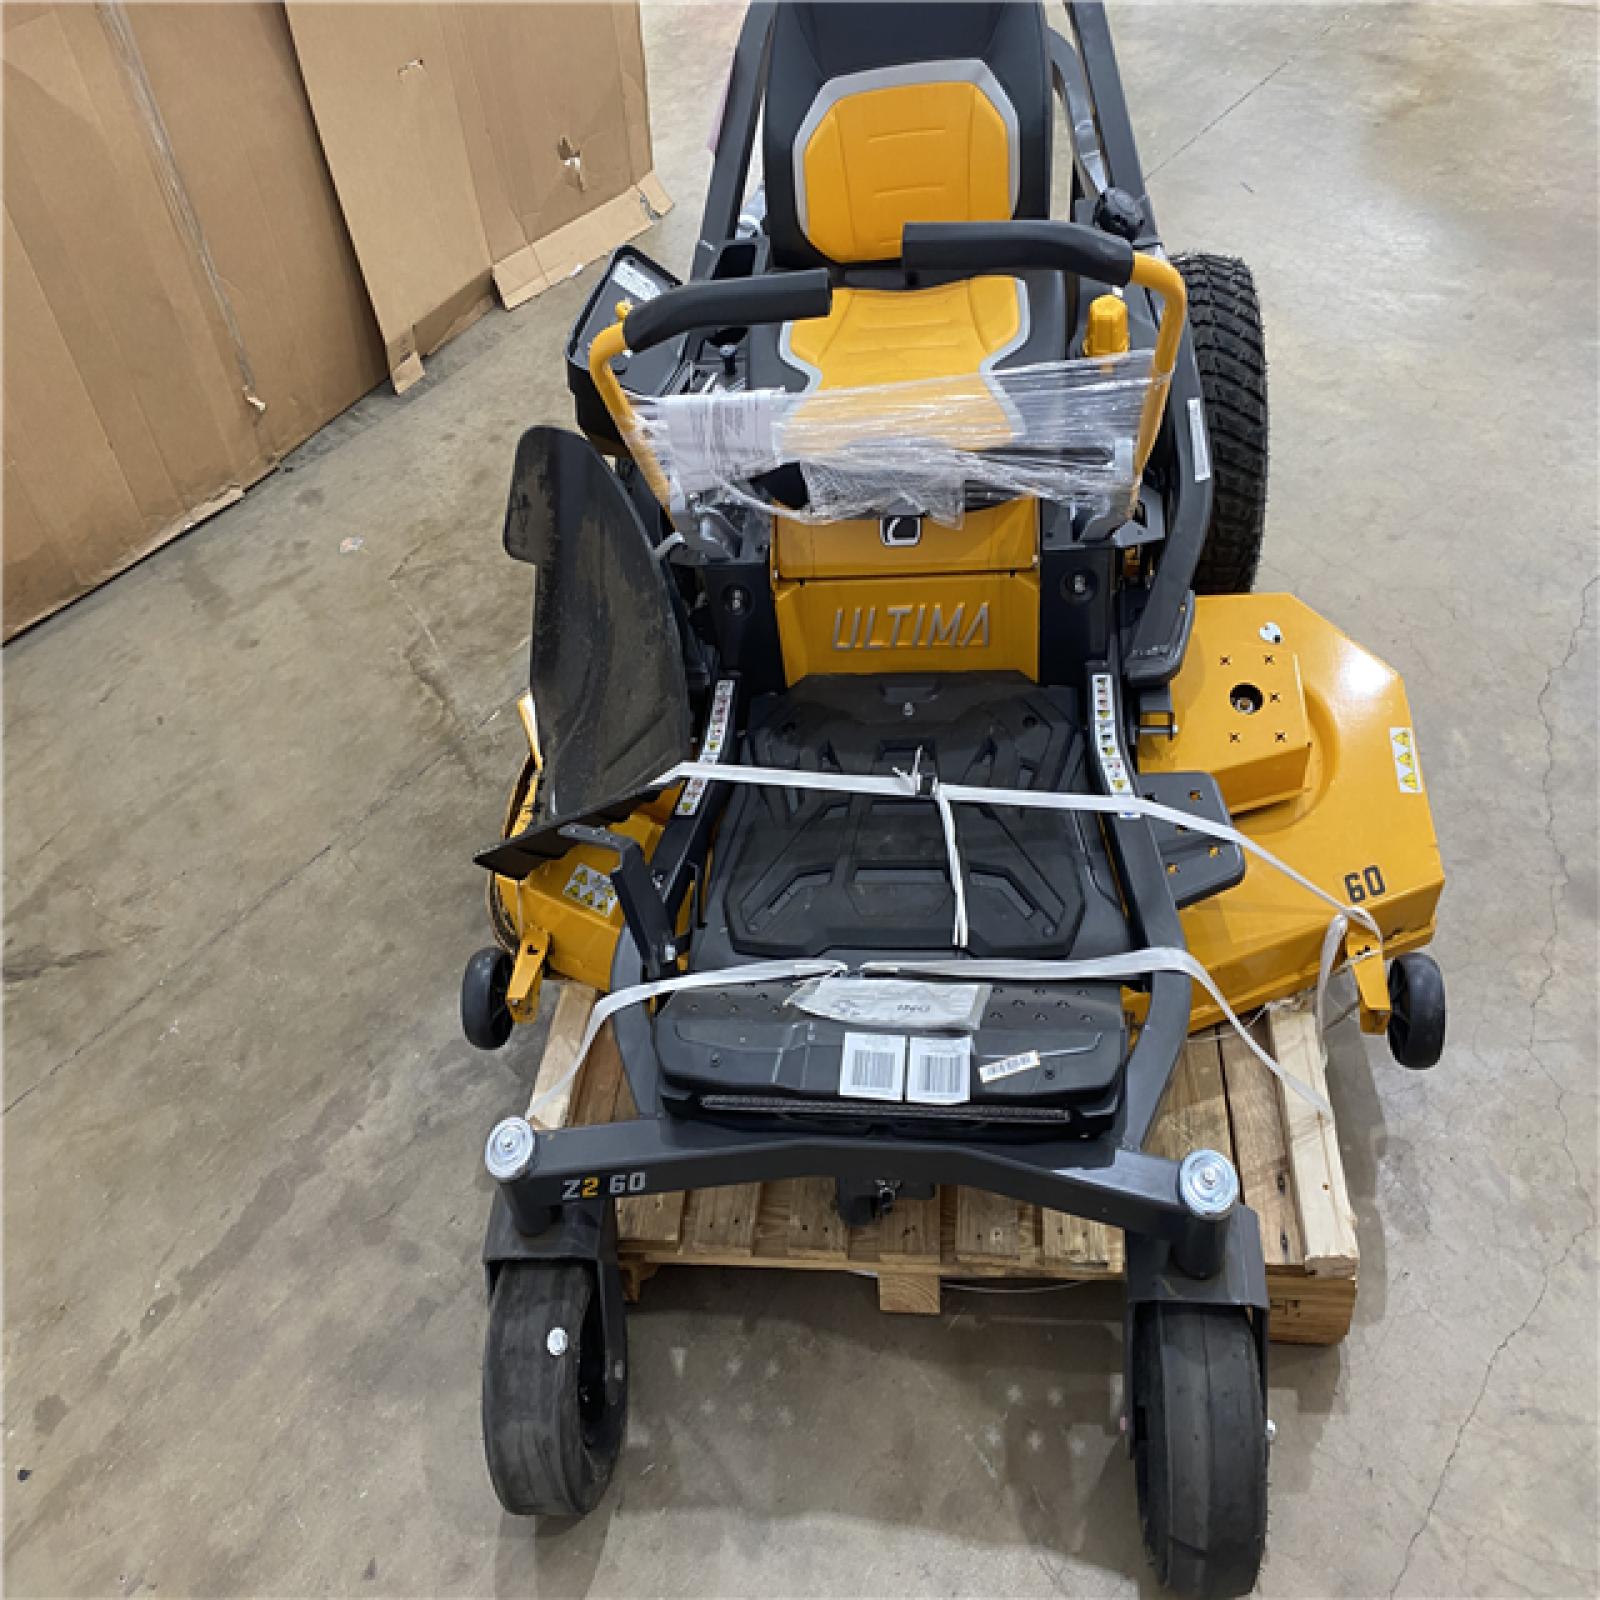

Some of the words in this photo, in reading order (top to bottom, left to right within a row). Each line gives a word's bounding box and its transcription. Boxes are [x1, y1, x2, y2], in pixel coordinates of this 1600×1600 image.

[832, 601, 990, 650] ULTIMA
[1344, 865, 1386, 903] 60
[562, 1176, 599, 1200] Z2
[609, 1171, 646, 1194] 60
